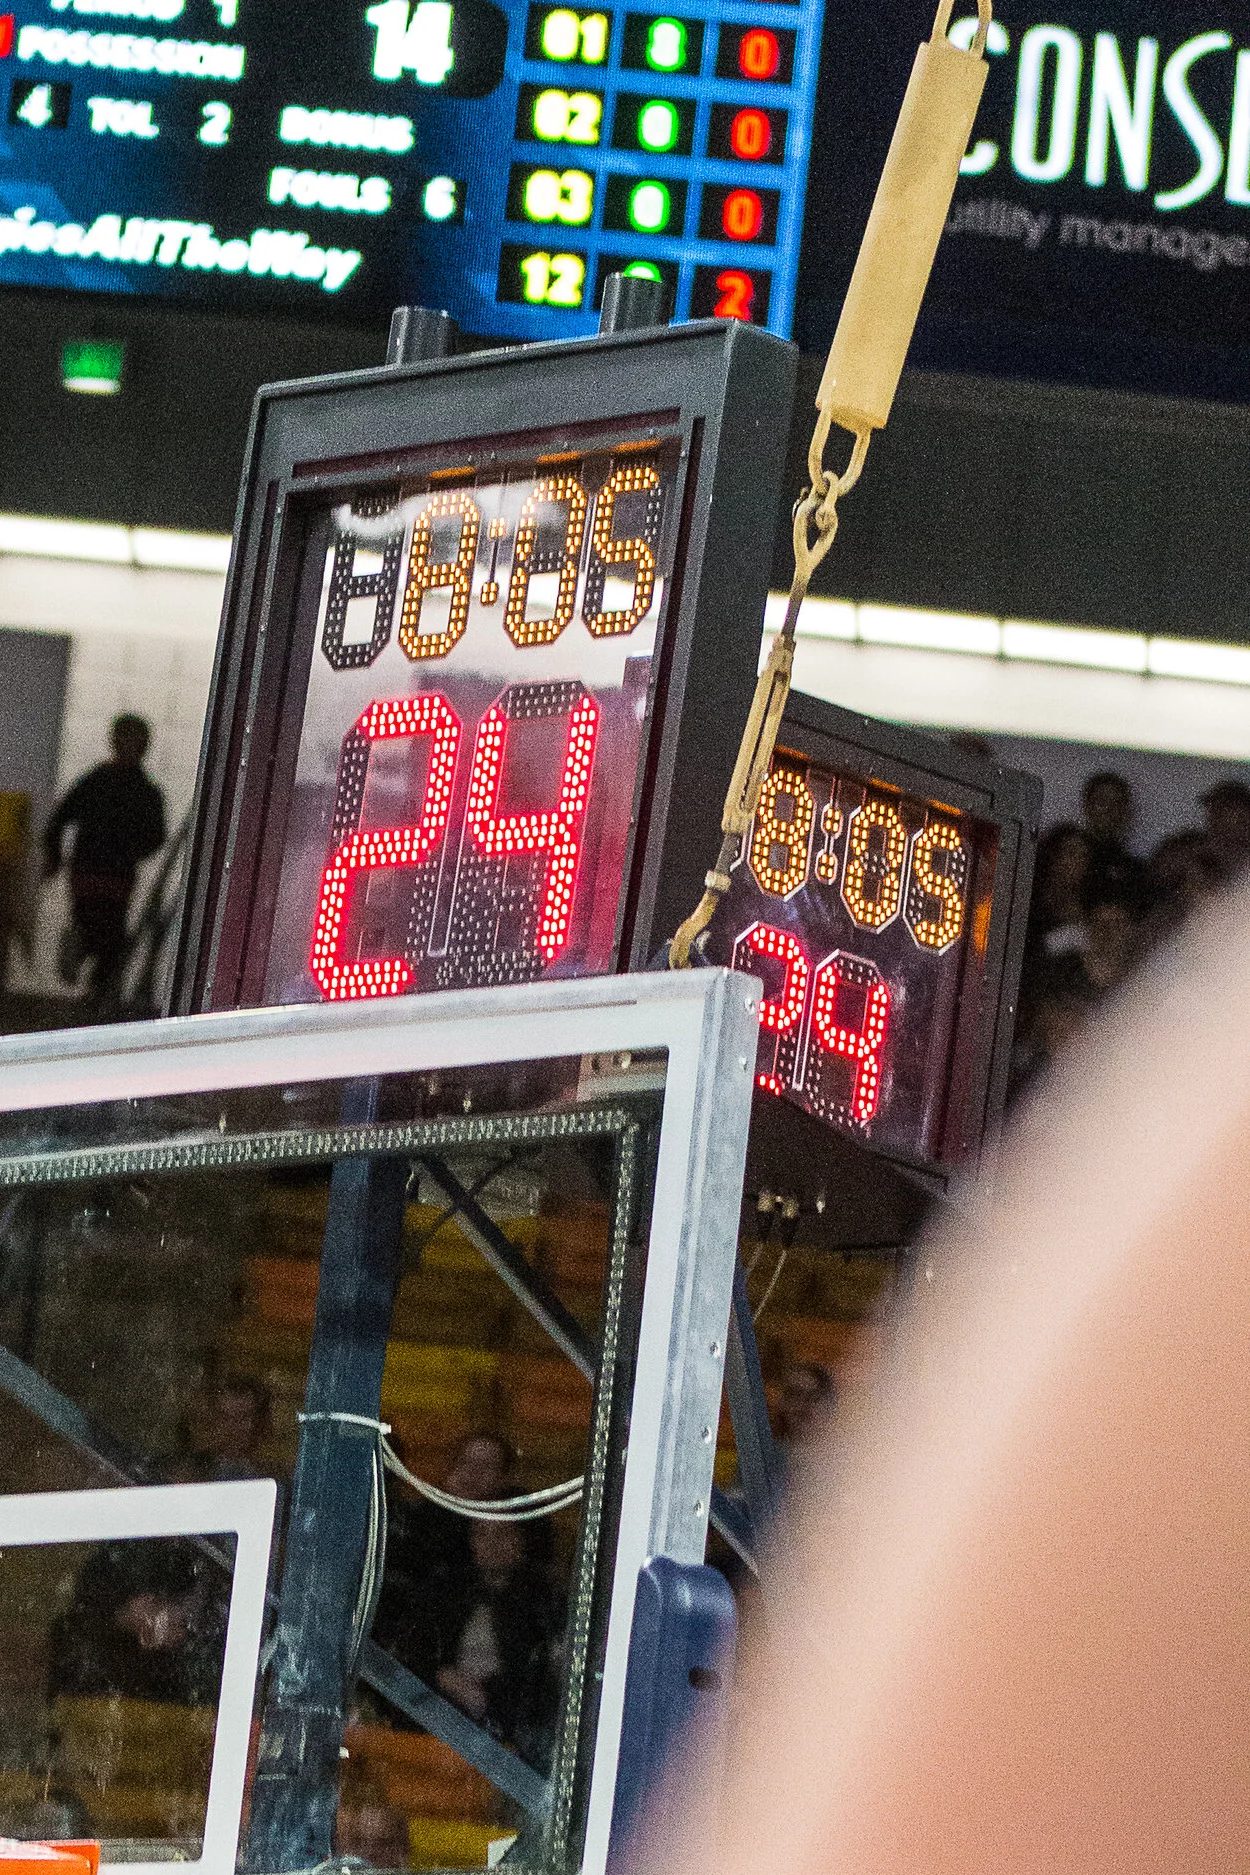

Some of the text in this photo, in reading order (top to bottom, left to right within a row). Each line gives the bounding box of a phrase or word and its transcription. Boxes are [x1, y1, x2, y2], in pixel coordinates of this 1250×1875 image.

[17, 24, 246, 81] POSSESSION
[365, 0, 454, 85] 14
[17, 82, 53, 128] 4
[199, 100, 232, 145] 2
[267, 166, 456, 222] FOULS 6
[521, 251, 587, 307] 12
[310, 690, 602, 1001] 24
